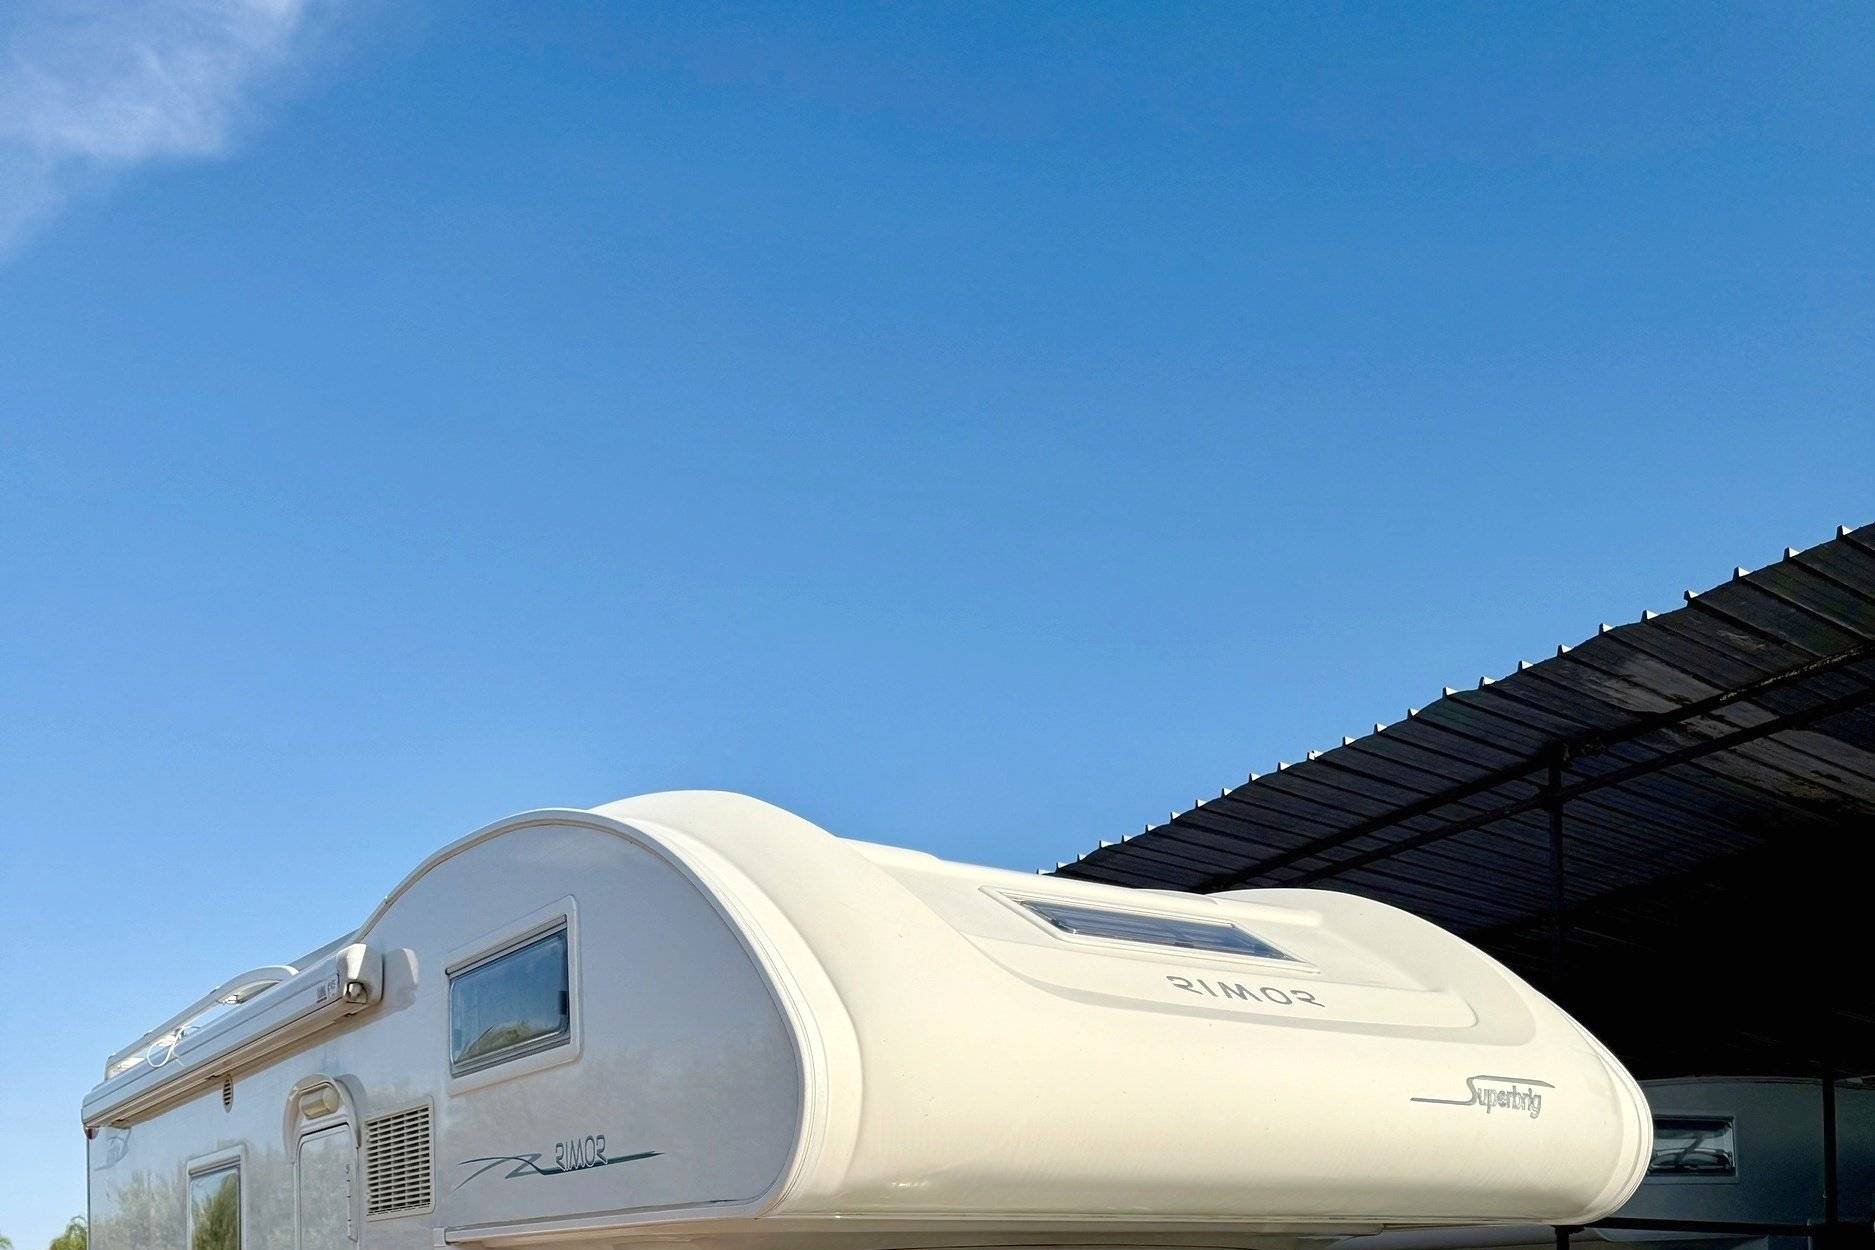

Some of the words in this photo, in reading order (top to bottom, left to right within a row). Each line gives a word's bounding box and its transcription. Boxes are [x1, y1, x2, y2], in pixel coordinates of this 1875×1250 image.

[1166, 975, 1326, 1008] RIMOR
[1465, 1075, 1555, 1119] Superbrig
[555, 1134, 608, 1171] RIMOR
